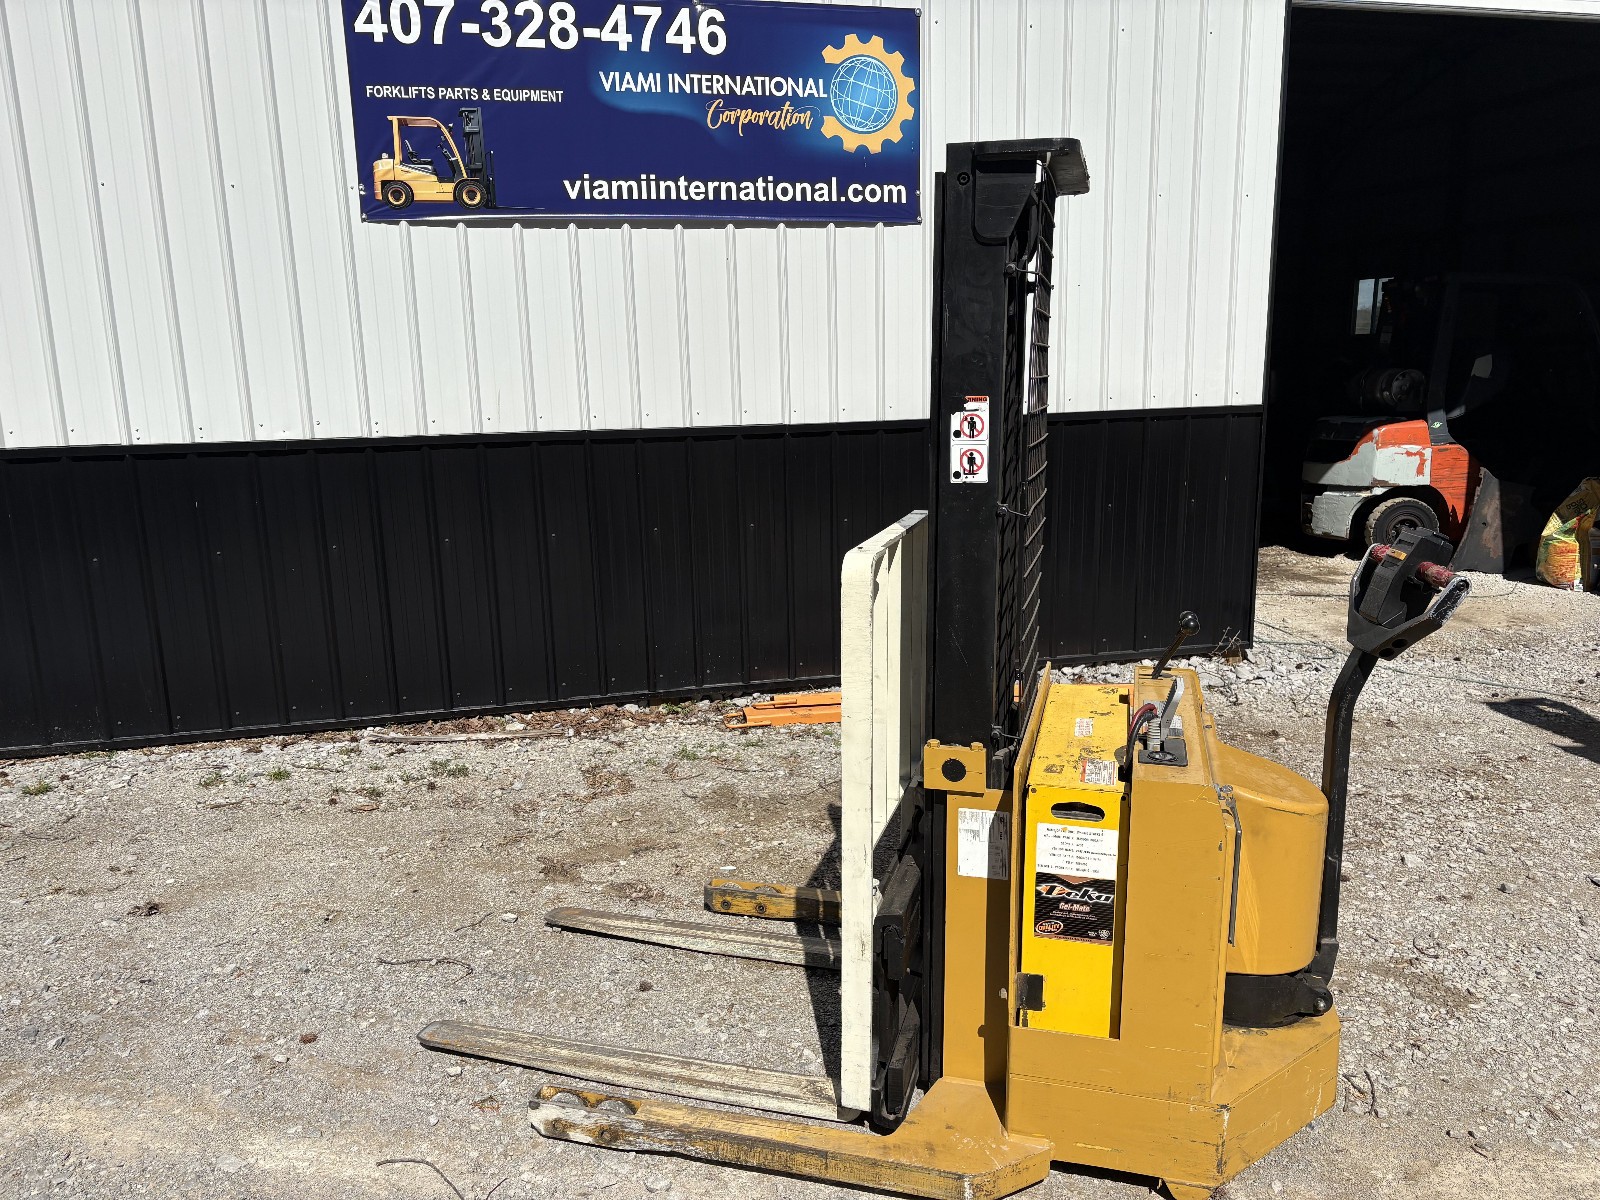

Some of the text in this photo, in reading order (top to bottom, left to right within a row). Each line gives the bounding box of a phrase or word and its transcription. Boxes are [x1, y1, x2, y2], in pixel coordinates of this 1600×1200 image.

[354, 0, 727, 55] 407-328-4746
[366, 85, 563, 102] FORKLIFTS PARTS & EQUIPMENT
[599, 71, 828, 98] VIAMI INTERNATIONAL
[706, 99, 820, 136] Corporation
[563, 174, 907, 204] viamiinternational.com
